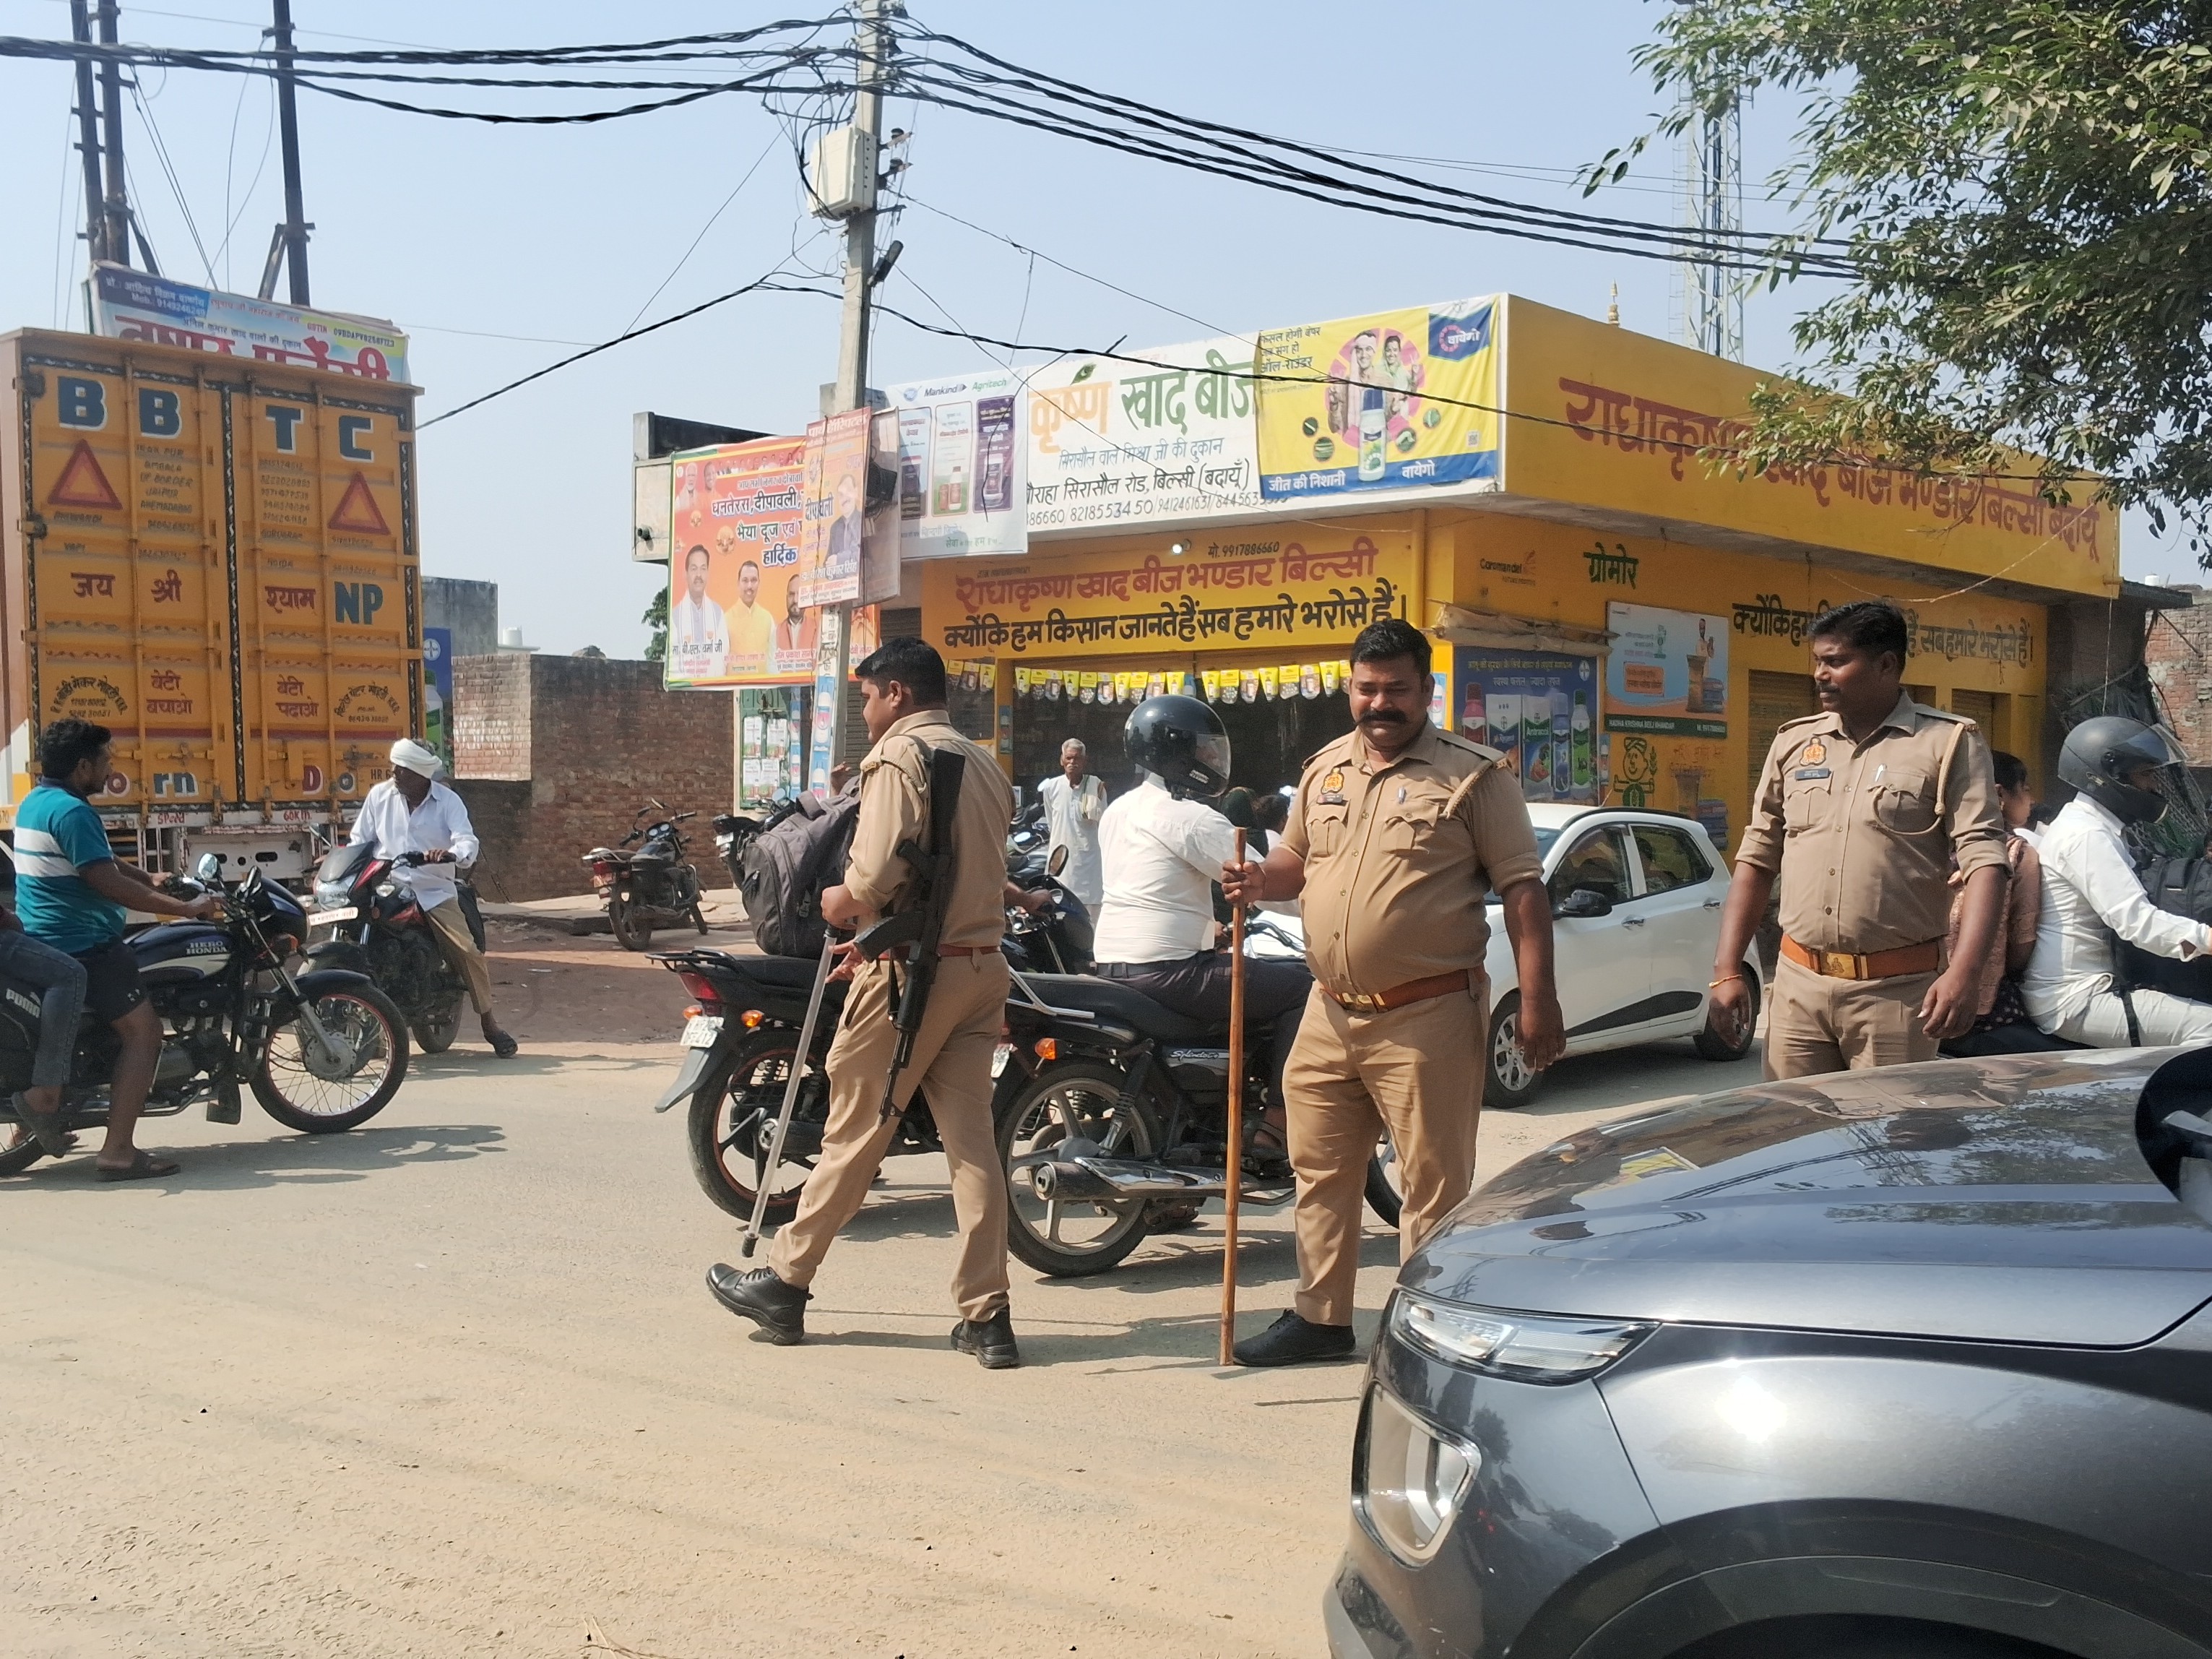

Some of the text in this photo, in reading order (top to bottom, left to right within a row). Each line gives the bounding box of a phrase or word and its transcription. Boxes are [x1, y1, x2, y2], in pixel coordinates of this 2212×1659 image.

[1286, 327, 1303, 342] होगी
[1448, 327, 1481, 345] वायेगो
[1292, 341, 1300, 355] हो
[924, 377, 1007, 397] Mankind Agritech
[1120, 371, 1189, 435] खाद
[1195, 349, 1256, 421] बीज
[1154, 439, 1168, 462] जी
[1172, 437, 1187, 457] की
[1191, 438, 1224, 462] दुकान
[1401, 459, 1436, 479] वायेगो
[1063, 471, 1120, 500] सिरासौल
[1153, 465, 1195, 491] बिल्सी
[1269, 470, 1347, 492] जीत की निशानी
[754, 486, 801, 510] दीपावली,
[737, 520, 757, 540] भैया
[761, 522, 779, 543] दूज
[763, 543, 798, 565] हार्दिक
[844, 559, 858, 574] सिंह
[956, 536, 1379, 613] राधाकृष्ण खाद बीज भण्डार बिल्सी
[1583, 541, 1640, 590] ग्रोमोर
[70, 569, 317, 615] जय श्री श्याम
[333, 581, 384, 626] NP
[1045, 608, 1119, 645] किसान
[1235, 592, 1298, 641] हमारे
[1301, 586, 1370, 631] भरोसे
[714, 639, 722, 654] जी
[150, 669, 182, 691] बेटी
[277, 673, 305, 697] बेटी
[146, 693, 194, 715] बचाओ
[1526, 726, 1550, 737] Antracol
[186, 946, 228, 955] HONDA
[190, 940, 224, 949] HERO
